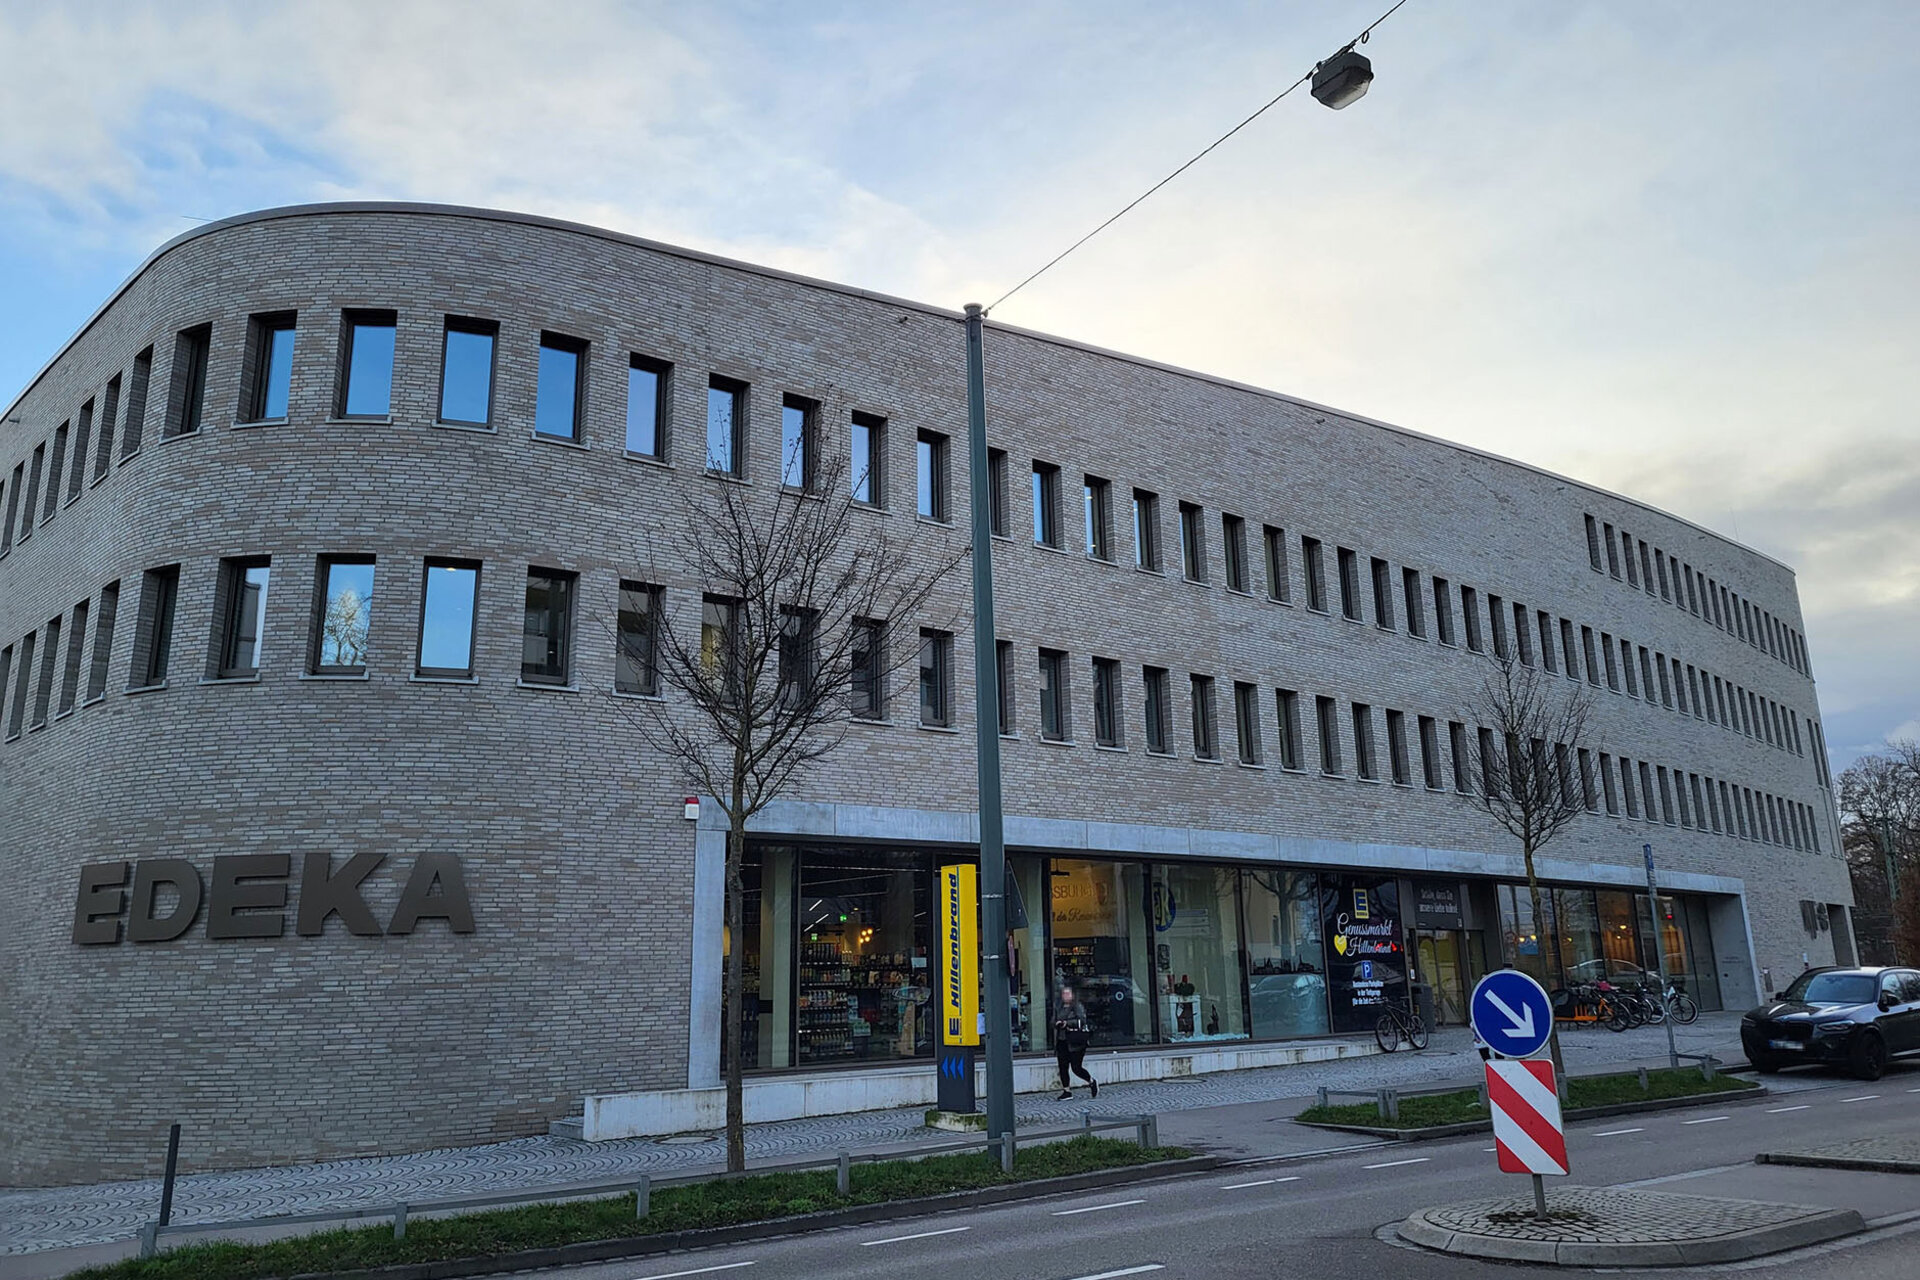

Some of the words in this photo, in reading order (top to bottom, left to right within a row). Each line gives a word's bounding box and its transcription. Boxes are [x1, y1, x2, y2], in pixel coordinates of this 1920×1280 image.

[72, 853, 476, 944] EDEKA
[1337, 912, 1392, 937] Genussmarkt
[948, 873, 960, 1008] Hillenbrand
[1346, 936, 1391, 957] Hillenbrand
